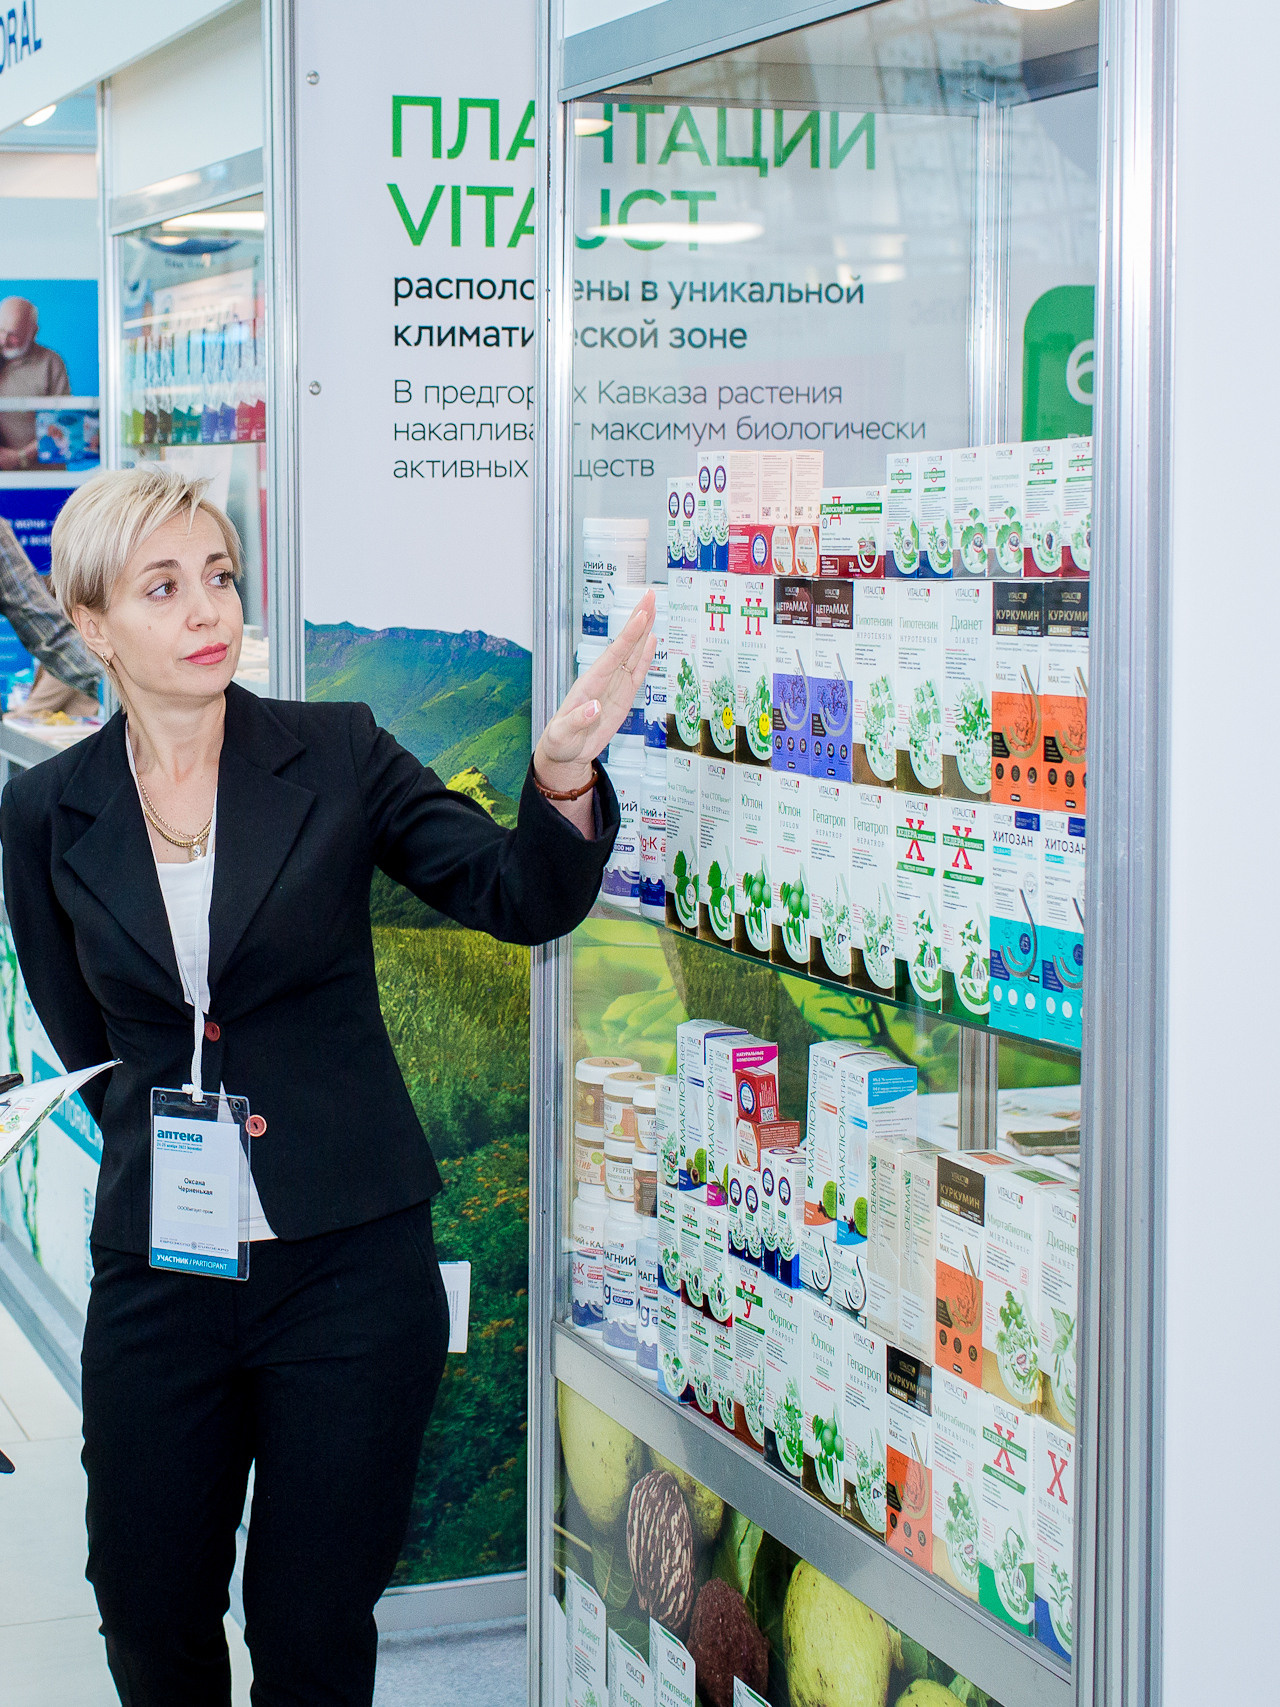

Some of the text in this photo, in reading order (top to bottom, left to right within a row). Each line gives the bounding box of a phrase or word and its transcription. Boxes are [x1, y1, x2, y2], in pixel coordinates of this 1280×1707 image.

[394, 275, 864, 309] располоены в уникальной
[394, 318, 748, 349] климатиской зоне
[394, 380, 412, 403] В
[598, 379, 707, 404] Кавказа
[718, 386, 842, 410] растения
[591, 422, 725, 446] максимум
[736, 416, 926, 441] биологически
[393, 459, 528, 478] активных
[856, 613, 893, 627] Гипотензин
[900, 616, 939, 630] Гипотензин
[950, 614, 983, 632] Дианет
[996, 610, 1040, 621] КУРКУМИН
[812, 808, 846, 828] Гепатроп
[853, 816, 889, 836] Гепатроп
[992, 830, 1034, 848] ХИТОЗАН
[157, 1129, 203, 1143] аптека
[940, 1184, 980, 1209] КУРКУМИН
[987, 1212, 1033, 1242] Миртабиотик
[156, 1254, 189, 1265] УЧАСТНИК
[768, 1308, 799, 1334] Форпост
[847, 1352, 882, 1384] Гепатроп
[934, 1404, 977, 1437] Миртабиотик
[577, 1617, 601, 1647] Дианет
